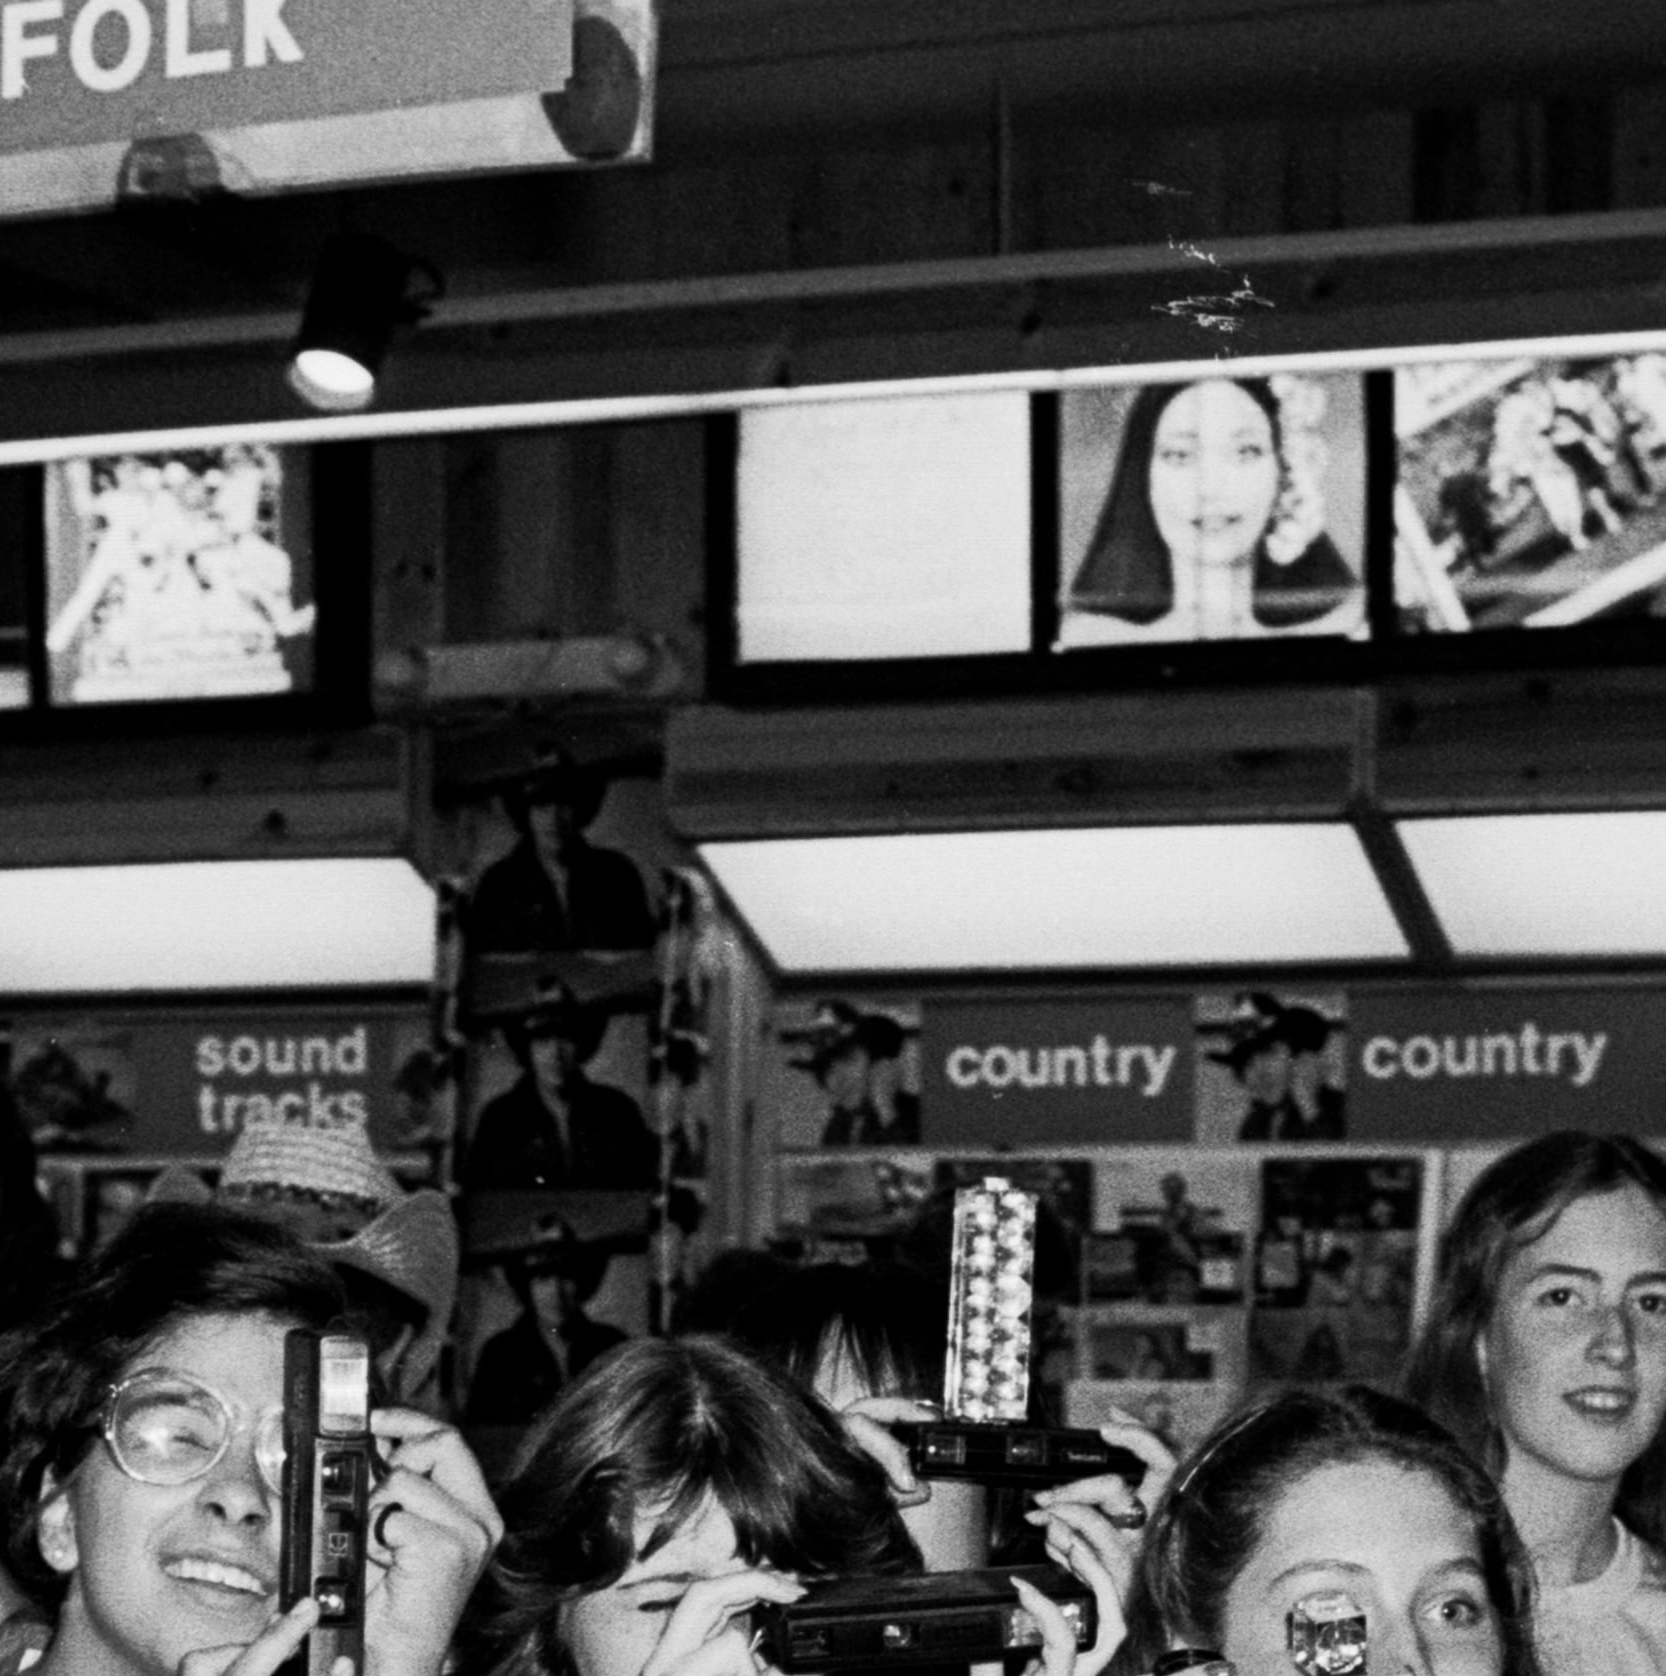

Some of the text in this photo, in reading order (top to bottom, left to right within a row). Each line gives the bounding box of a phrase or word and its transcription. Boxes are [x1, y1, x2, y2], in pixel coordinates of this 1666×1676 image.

[0, 0, 305, 100] FOLK
[196, 1025, 368, 1077] sound
[945, 1033, 1178, 1098] country
[1362, 1020, 1609, 1088] country
[199, 1079, 369, 1133] tracks
